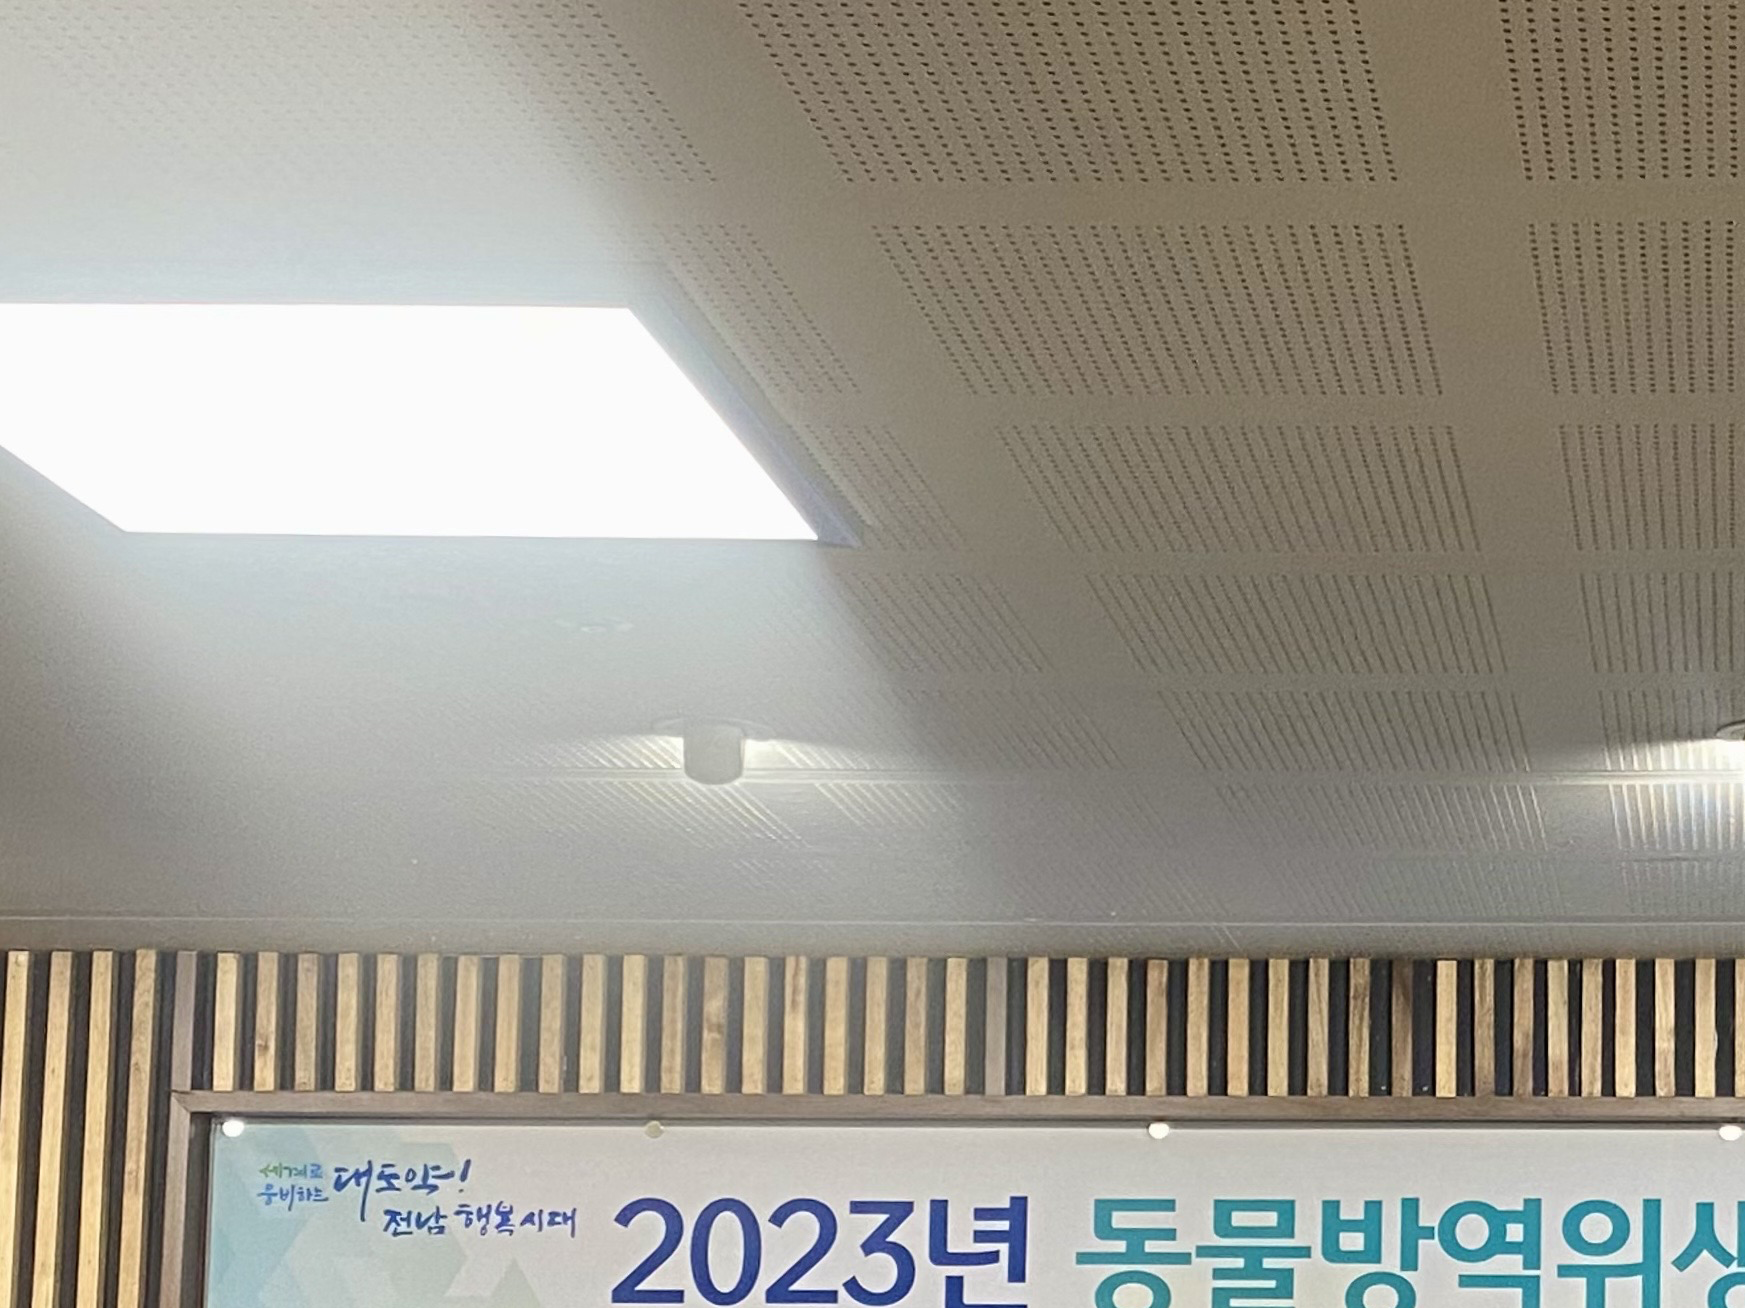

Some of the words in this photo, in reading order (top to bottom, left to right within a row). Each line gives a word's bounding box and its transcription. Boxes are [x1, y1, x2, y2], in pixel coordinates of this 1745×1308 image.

[383, 1205, 448, 1237] 전남
[454, 1201, 514, 1236] 행복
[520, 1207, 577, 1238] 시대
